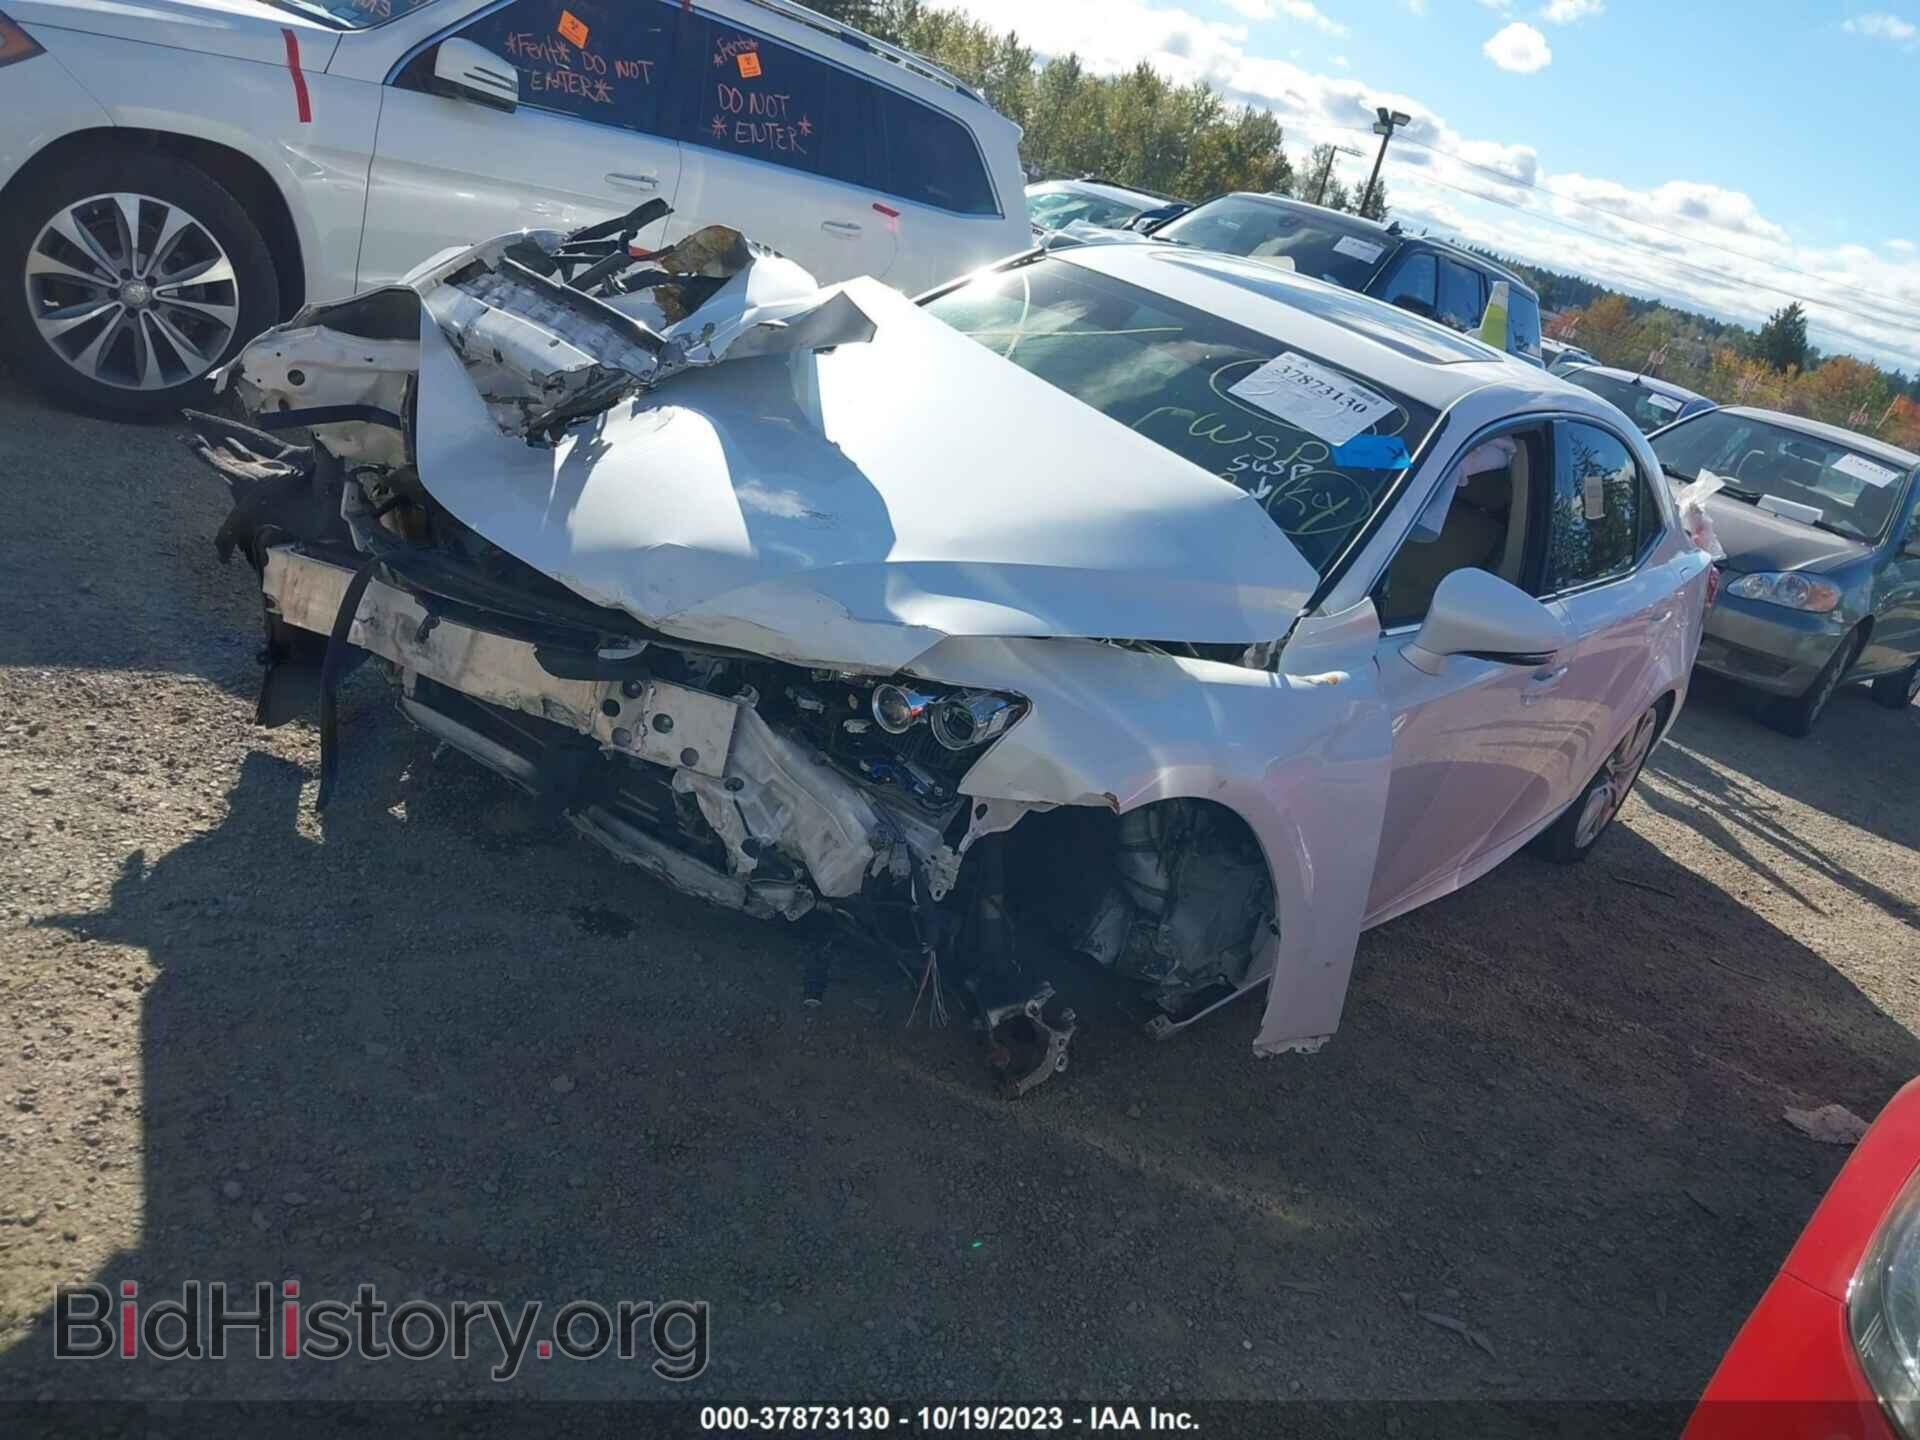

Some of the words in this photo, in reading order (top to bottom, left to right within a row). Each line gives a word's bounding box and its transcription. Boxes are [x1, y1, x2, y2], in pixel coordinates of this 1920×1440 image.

[581, 51, 607, 75] DO
[614, 60, 655, 84] NOT
[718, 83, 744, 113] DO
[750, 93, 790, 120] NOT
[735, 121, 807, 154] ENTER
[1277, 365, 1368, 413] 37873130
